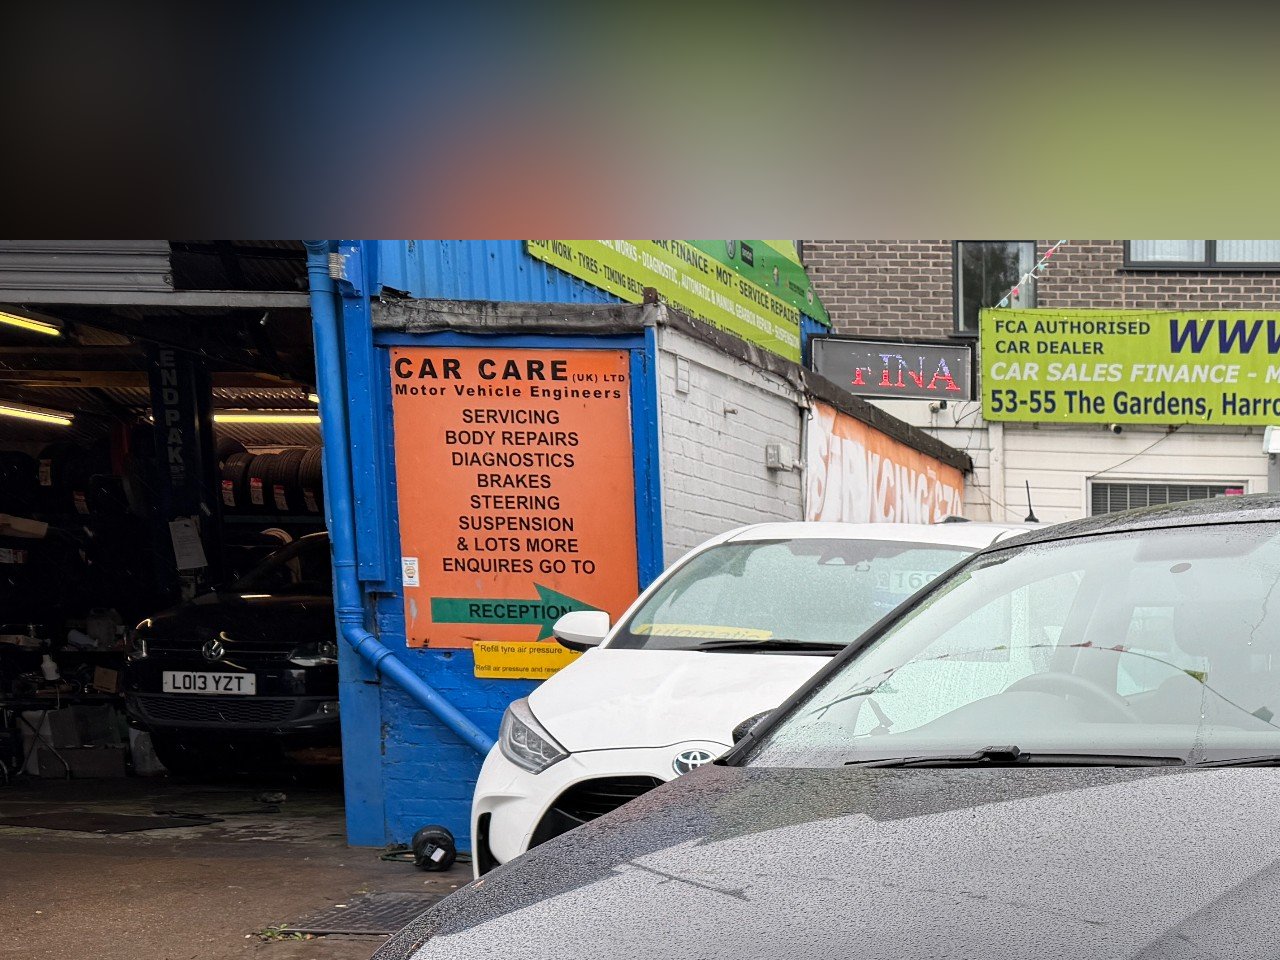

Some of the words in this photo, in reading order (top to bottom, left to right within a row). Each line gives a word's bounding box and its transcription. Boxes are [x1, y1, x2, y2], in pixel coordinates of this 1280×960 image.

[552, 240, 572, 262] WORK
[578, 251, 598, 274] TYRES
[603, 264, 626, 288] TIMING
[652, 240, 669, 251] AR
[671, 240, 709, 274] FINANCE
[716, 265, 732, 288] MOT
[739, 280, 769, 310] SERVICE
[770, 297, 799, 326] REPAIRS
[995, 320, 1028, 334] FCA
[1033, 320, 1151, 336] AUTHORISED
[995, 340, 1031, 354] CAR
[1037, 341, 1105, 355] DEALER
[394, 357, 462, 379] CAR
[478, 358, 568, 381] CARE
[572, 373, 598, 383] (UK)
[603, 374, 625, 382] LTD
[990, 362, 1040, 382] CAR
[1046, 363, 1123, 383] SALES
[1130, 364, 1240, 385] FINANCE
[395, 384, 446, 396] Motor
[454, 385, 521, 397] Vehicle
[530, 386, 621, 400] Engineers
[990, 389, 1056, 414] 53-55
[1064, 390, 1105, 414] The
[1113, 391, 1213, 421] Gardens,
[462, 409, 560, 424] SERVICING
[446, 430, 496, 445] BODY
[502, 431, 579, 446] REPAIRS
[452, 452, 575, 467] DIAGNOSTICS
[477, 474, 551, 488] BRAKES
[470, 495, 560, 510] STEERING
[459, 516, 574, 531] SUSPENSION
[457, 537, 469, 551] &
[474, 537, 521, 552] LOTS
[526, 538, 579, 552] MORE
[443, 558, 533, 573] ENQUIRES
[539, 559, 566, 574] GO
[571, 560, 596, 574] TO
[469, 603, 572, 619] RECEPTION
[480, 644, 499, 652] Refill
[501, 646, 515, 654] tyre
[529, 646, 563, 655] pressure
[172, 674, 207, 690] LO13
[212, 675, 244, 691] YZT
